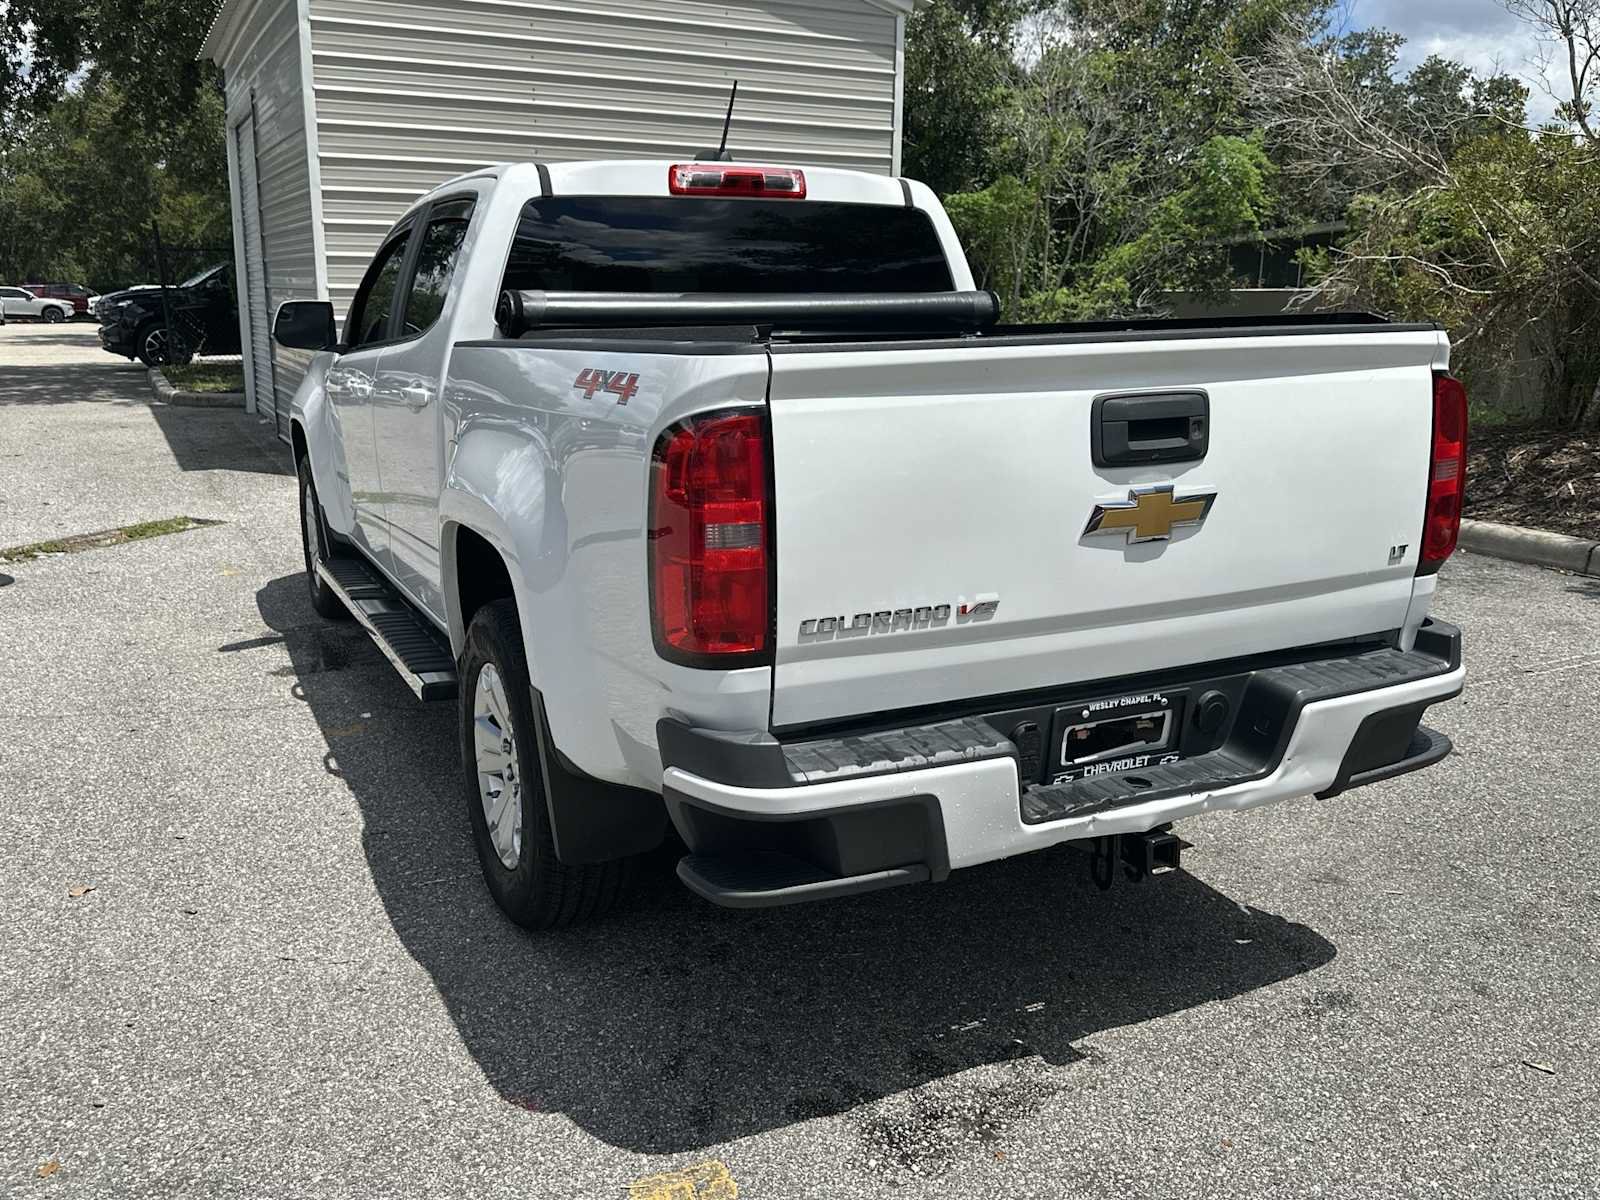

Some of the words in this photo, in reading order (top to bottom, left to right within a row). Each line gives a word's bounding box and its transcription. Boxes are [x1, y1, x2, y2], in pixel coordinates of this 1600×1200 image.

[1389, 544, 1408, 561] LT
[799, 603, 951, 640] COLORADO
[956, 600, 1000, 621] V6
[1089, 700, 1119, 711] WESLEY
[1120, 696, 1151, 706] CHAPEL,
[1153, 693, 1162, 701] FL
[1083, 756, 1151, 777] CHEVROLET
